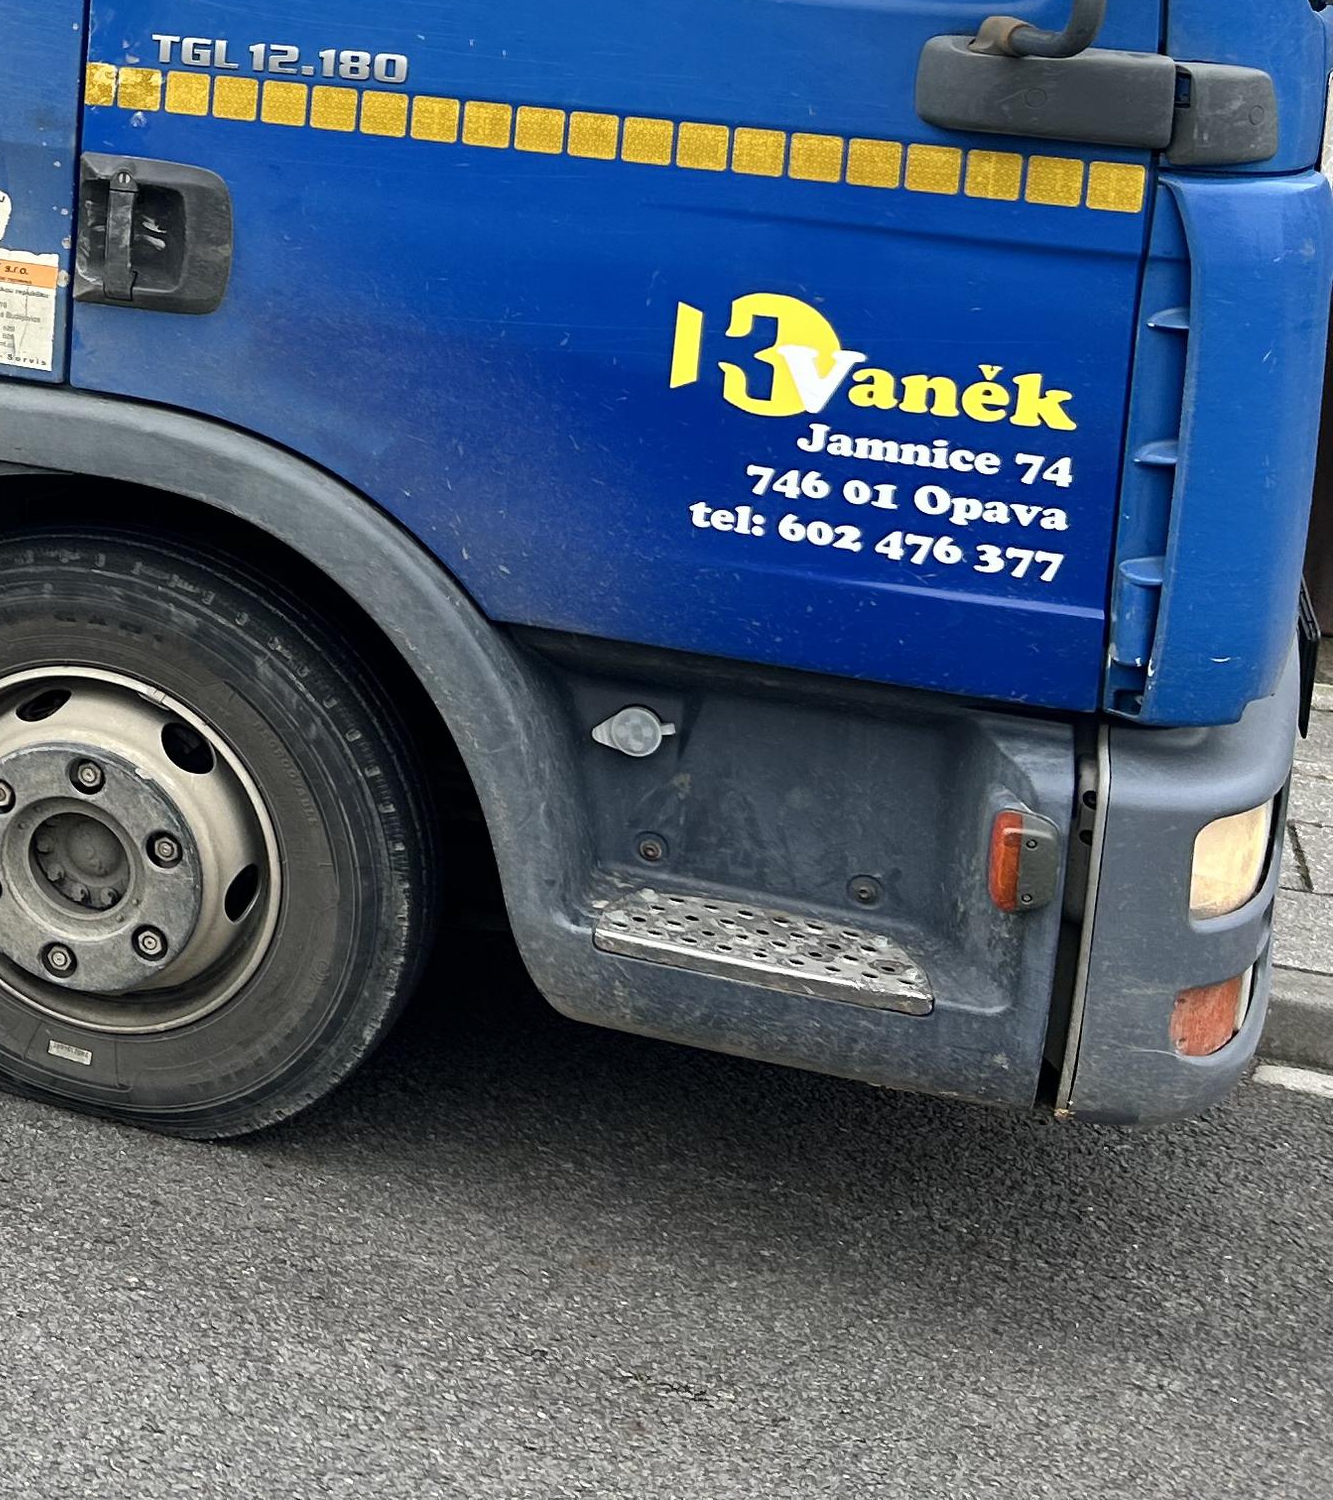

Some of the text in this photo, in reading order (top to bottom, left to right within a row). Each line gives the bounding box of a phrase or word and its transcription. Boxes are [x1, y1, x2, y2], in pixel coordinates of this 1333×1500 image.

[151, 34, 409, 84] TGL 12.180
[776, 343, 1078, 431] Vaněk
[795, 422, 1075, 489] Jamnice 74
[744, 464, 1070, 532] 746 01 Opava
[688, 499, 1065, 583] tel: 602 476 377
